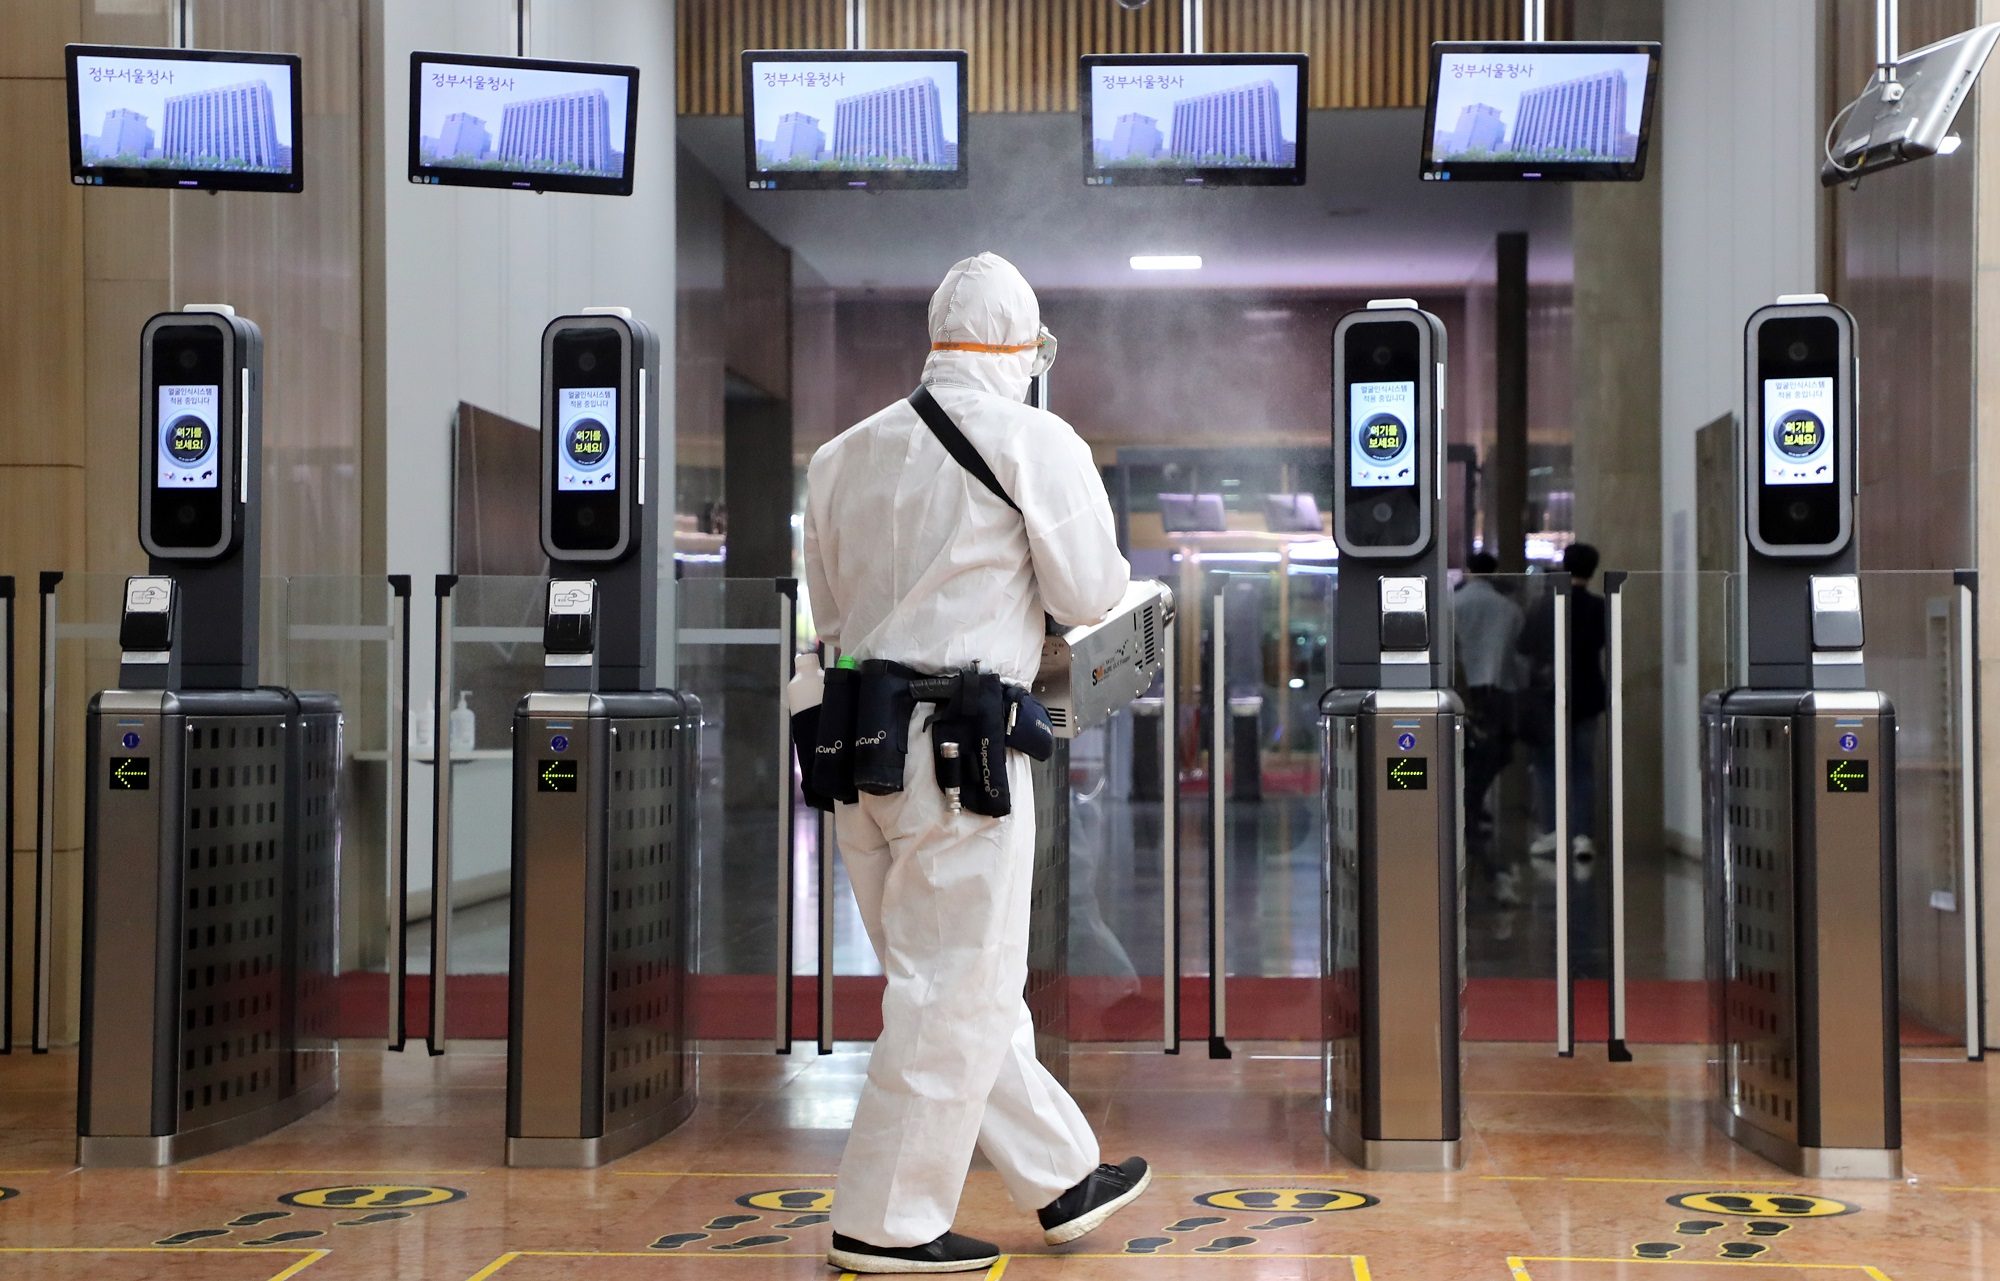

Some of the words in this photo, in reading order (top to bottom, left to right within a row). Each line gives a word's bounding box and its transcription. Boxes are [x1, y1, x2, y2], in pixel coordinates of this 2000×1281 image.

[89, 67, 175, 85] 정부서울청사
[1451, 63, 1534, 79] 정부서울청사
[432, 73, 515, 91] 정부서울청사
[763, 72, 845, 87] 정부서울청사
[1102, 75, 1184, 89] 정부서울청사
[1360, 384, 1408, 394] 얼굴인식시스템
[1776, 380, 1825, 390] 얼굴인식시스템
[168, 387, 213, 396] 얼굴인식시스템
[568, 390, 611, 399] 얼굴인식시스템
[175, 427, 202, 439] 여기를
[1370, 425, 1397, 437] 여기를
[1784, 421, 1815, 433] 여기를
[576, 430, 601, 441] 여기를
[1783, 433, 1817, 446] 보세요!
[174, 439, 203, 450] 보세요!
[574, 442, 602, 453] 보세요!
[1368, 437, 1399, 449] 보세요!
[981, 738, 991, 792] SuperCure
